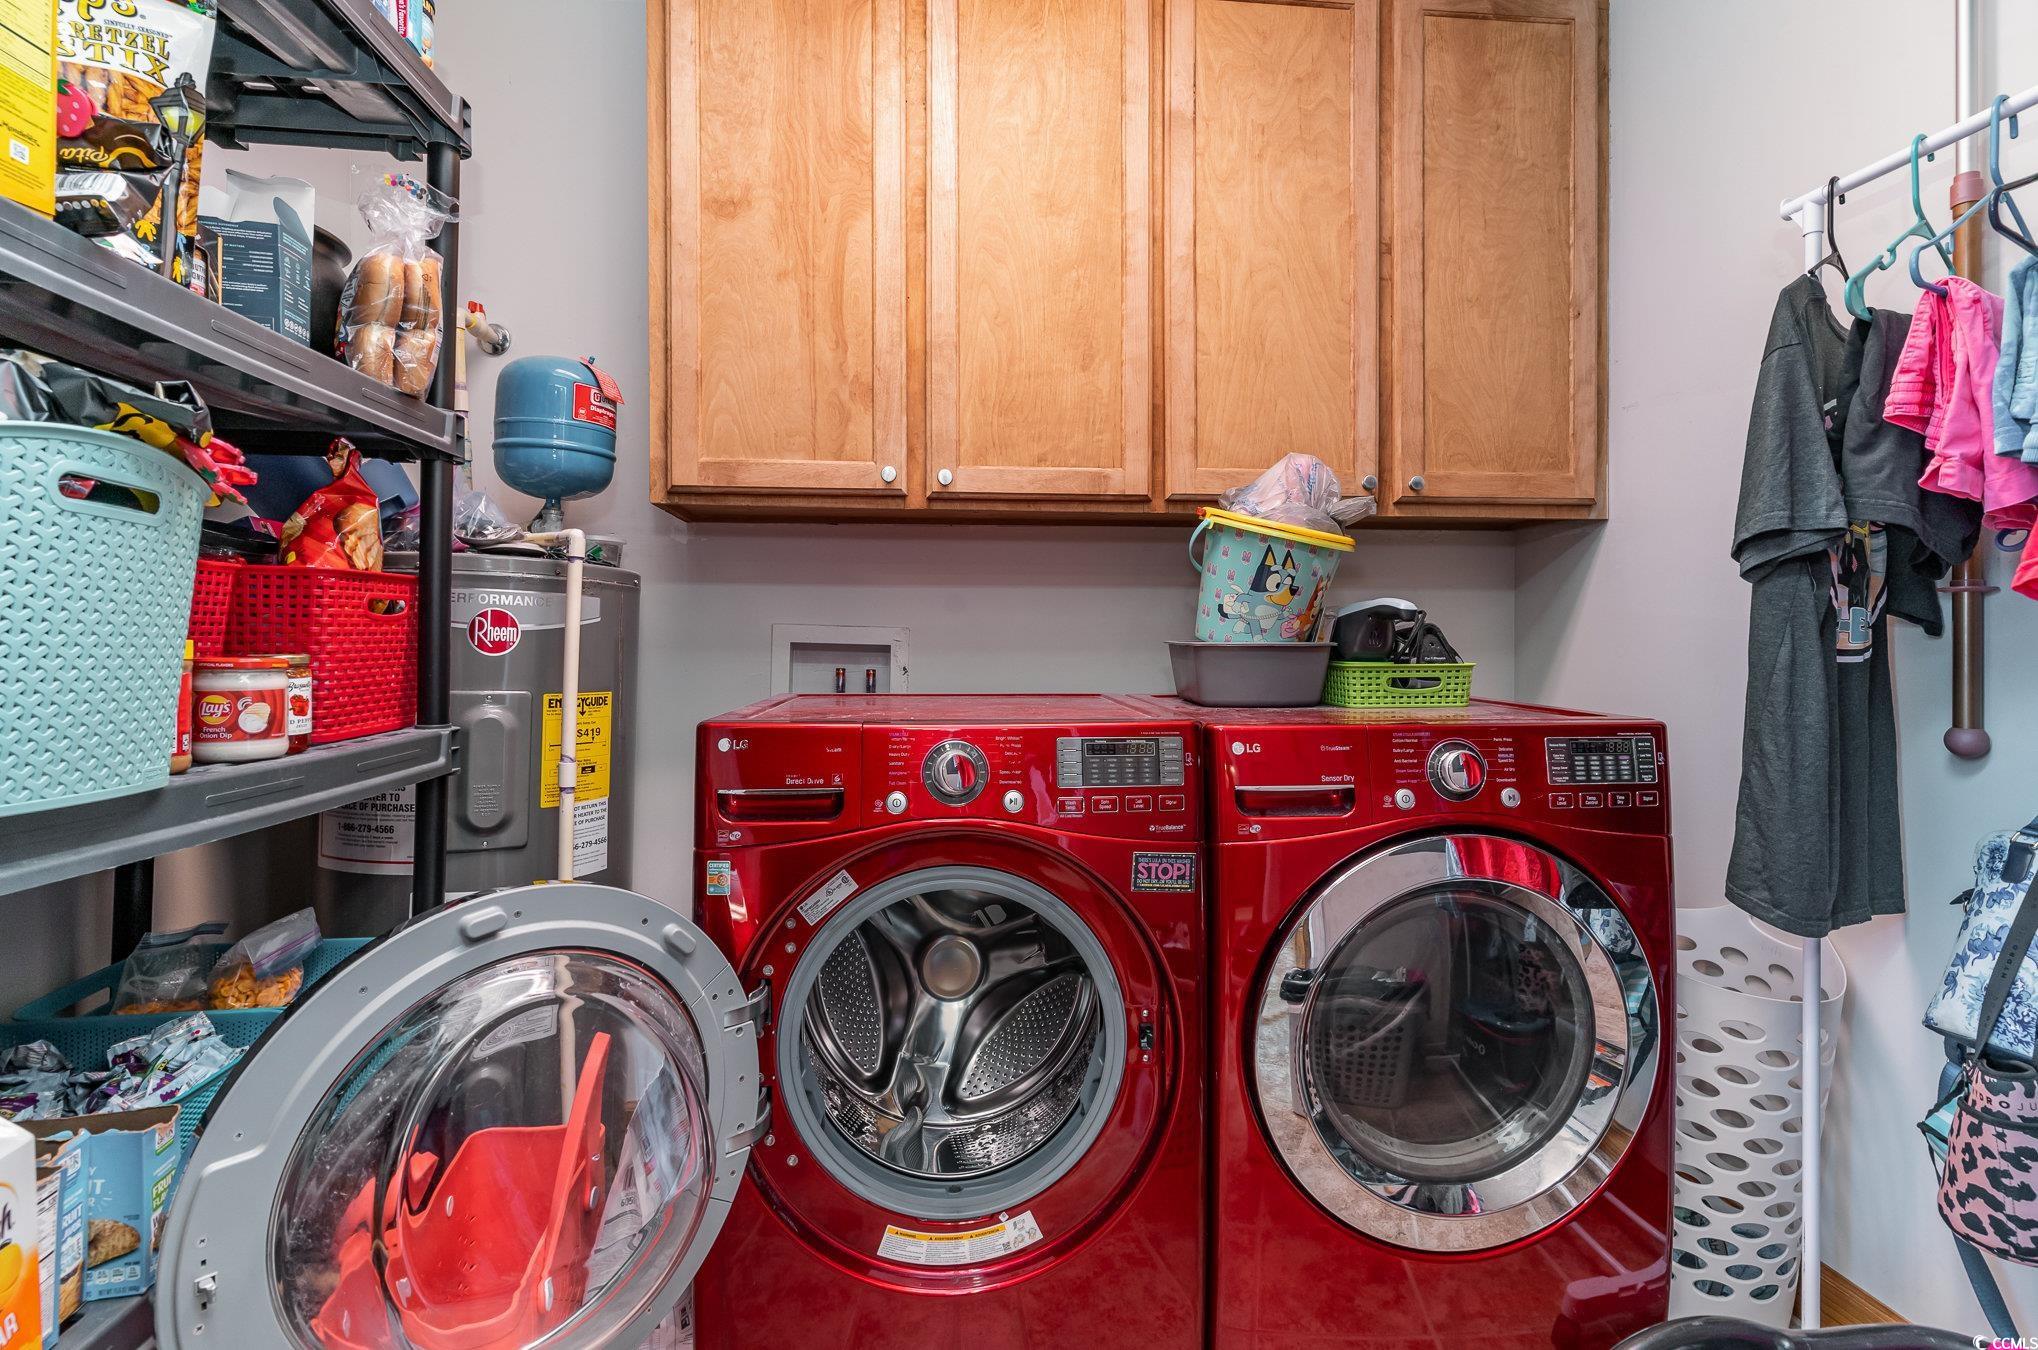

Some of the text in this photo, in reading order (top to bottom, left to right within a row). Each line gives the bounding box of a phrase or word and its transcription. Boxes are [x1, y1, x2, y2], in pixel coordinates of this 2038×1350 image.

[68, 20, 170, 61] RETZEL
[57, 37, 170, 87] STIX
[60, 146, 109, 163] Pita
[450, 592, 553, 607] ERFORMANCE
[474, 609, 518, 648] Rheem
[201, 700, 231, 718] Lay's
[548, 696, 608, 709] ENGYGUIDE
[219, 732, 233, 740] Dip
[1343, 774, 1355, 782] Dry
[389, 793, 400, 802] TO
[359, 803, 369, 811] OF
[371, 803, 415, 813] PURCHASE
[584, 815, 606, 823] PURCHASE
[338, 822, 395, 834] 1-866-279-4566
[573, 836, 608, 850] 6-279-4566
[1137, 862, 1190, 880] STOP!
